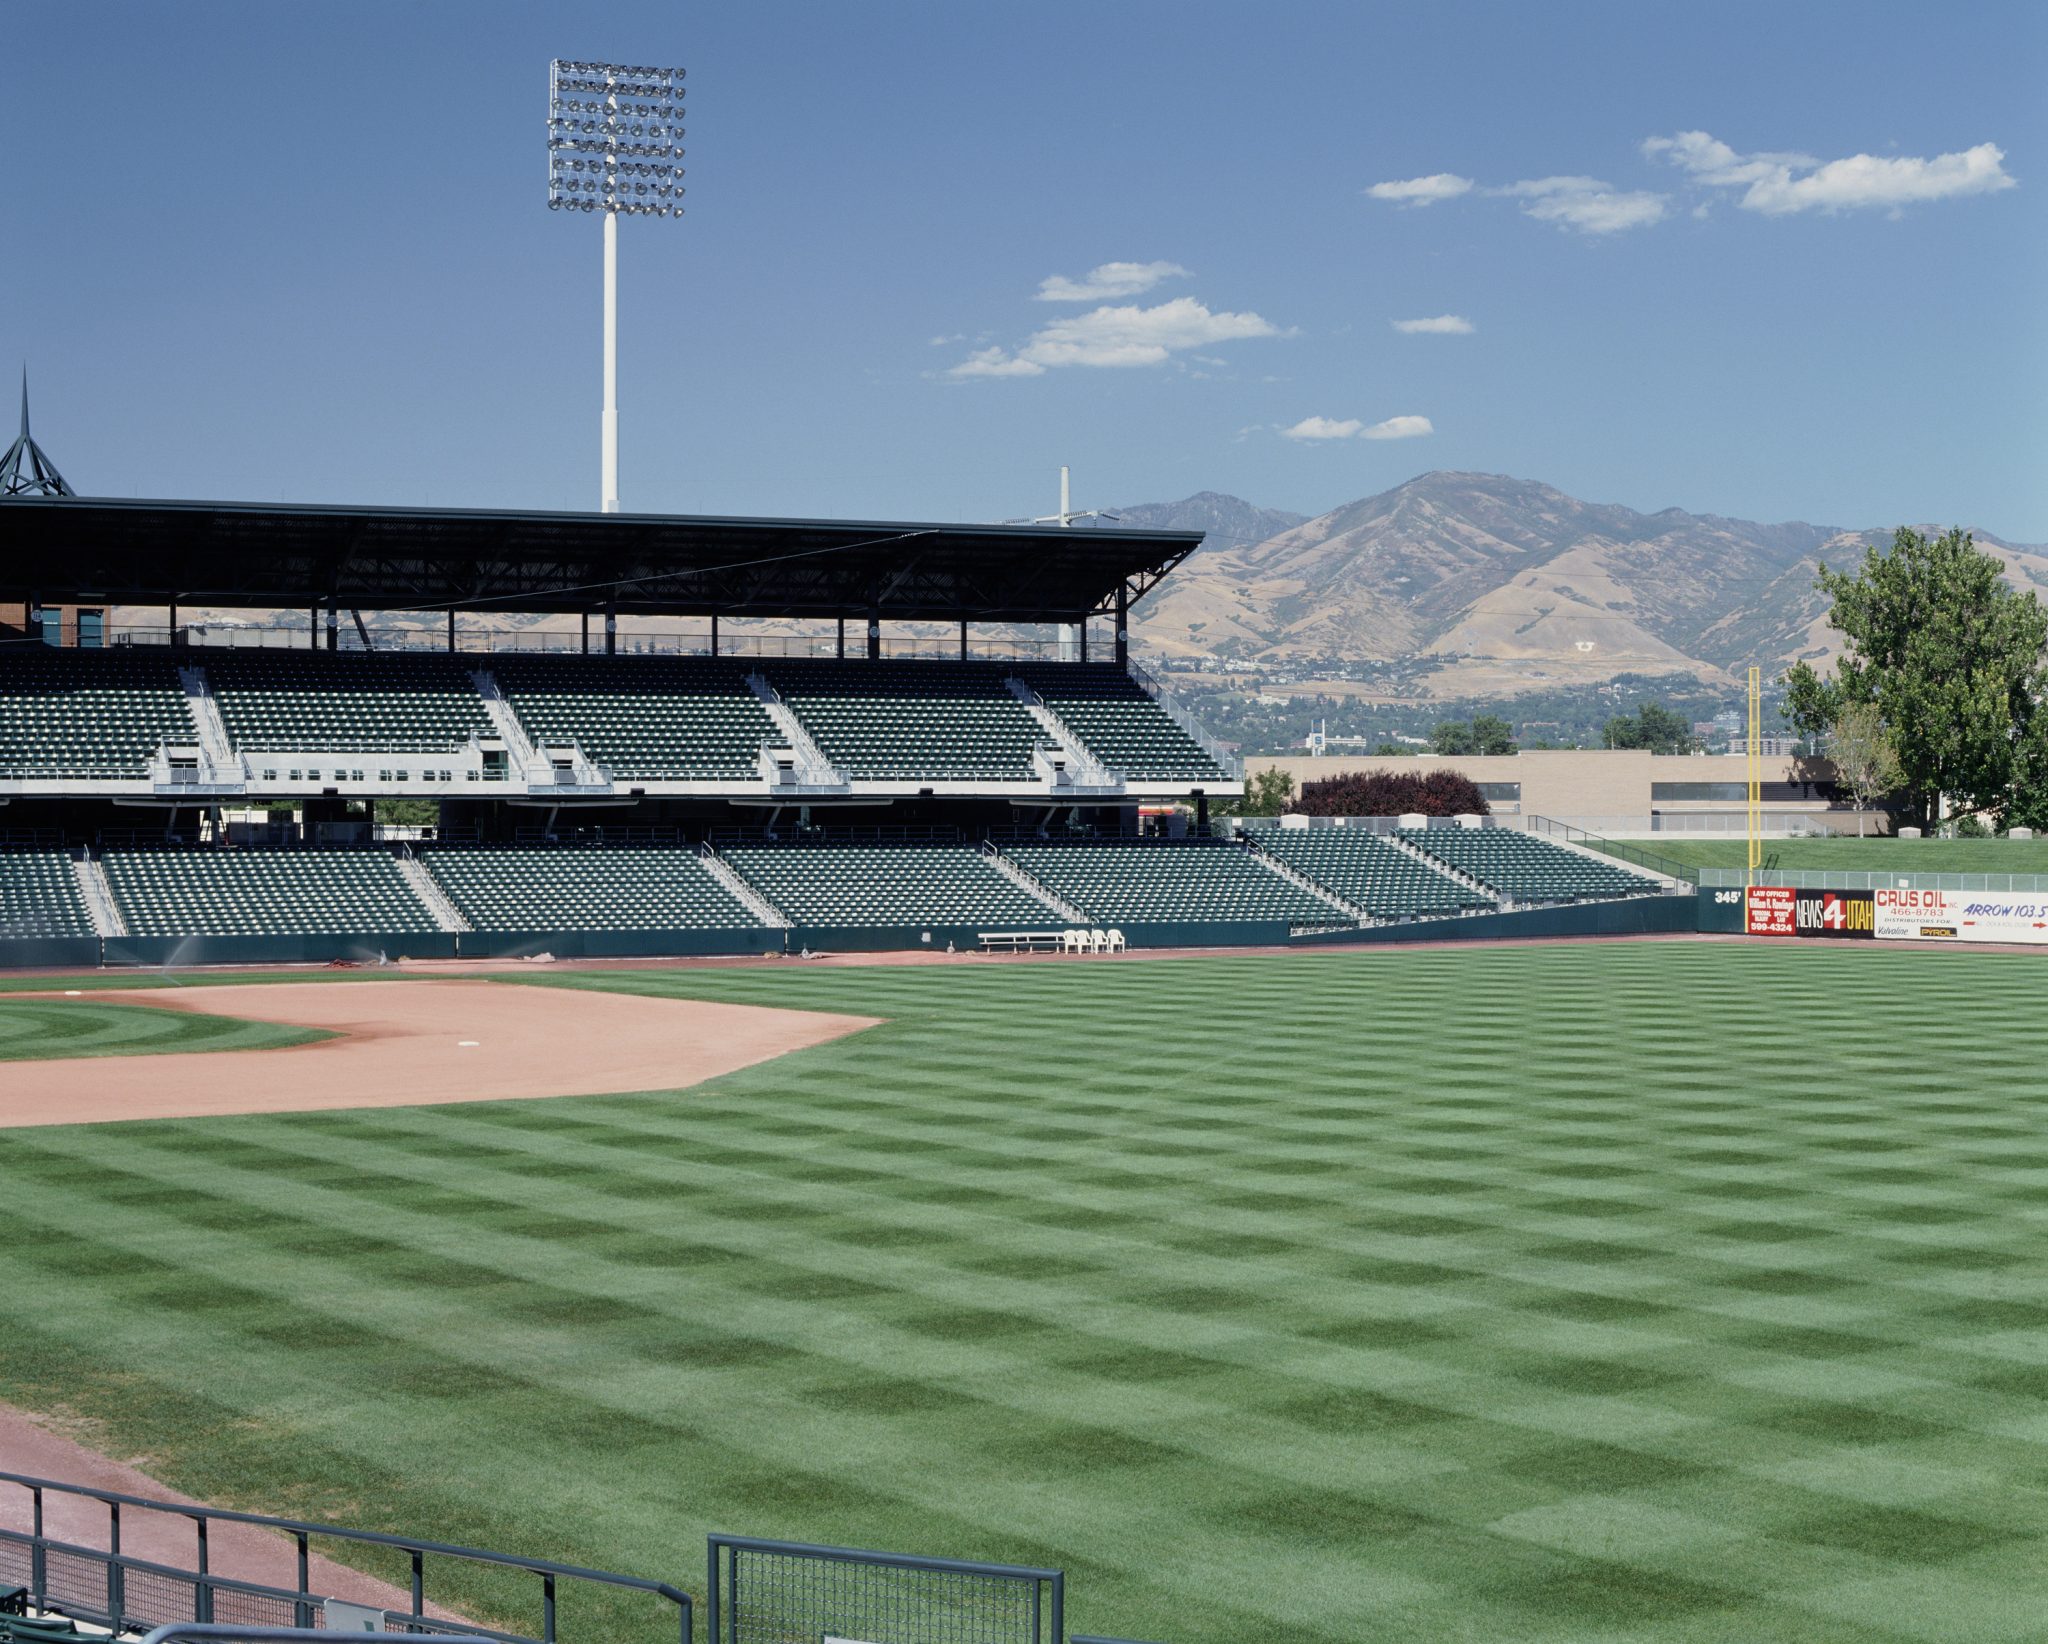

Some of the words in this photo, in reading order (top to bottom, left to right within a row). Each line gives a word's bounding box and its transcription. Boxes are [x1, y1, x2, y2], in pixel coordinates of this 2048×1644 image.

[1715, 891, 1741, 904] 345'
[1877, 890, 1918, 907] CRUS
[1923, 891, 1947, 908] OIL
[1796, 899, 1823, 929] NEWS
[1824, 900, 1846, 929] 4
[1846, 900, 1873, 930] UTAH
[1890, 908, 1944, 917] 466-8783
[1962, 903, 2014, 917] ARROW
[1751, 923, 1792, 932] 599-4324
[1878, 926, 1909, 935] Valvoline
